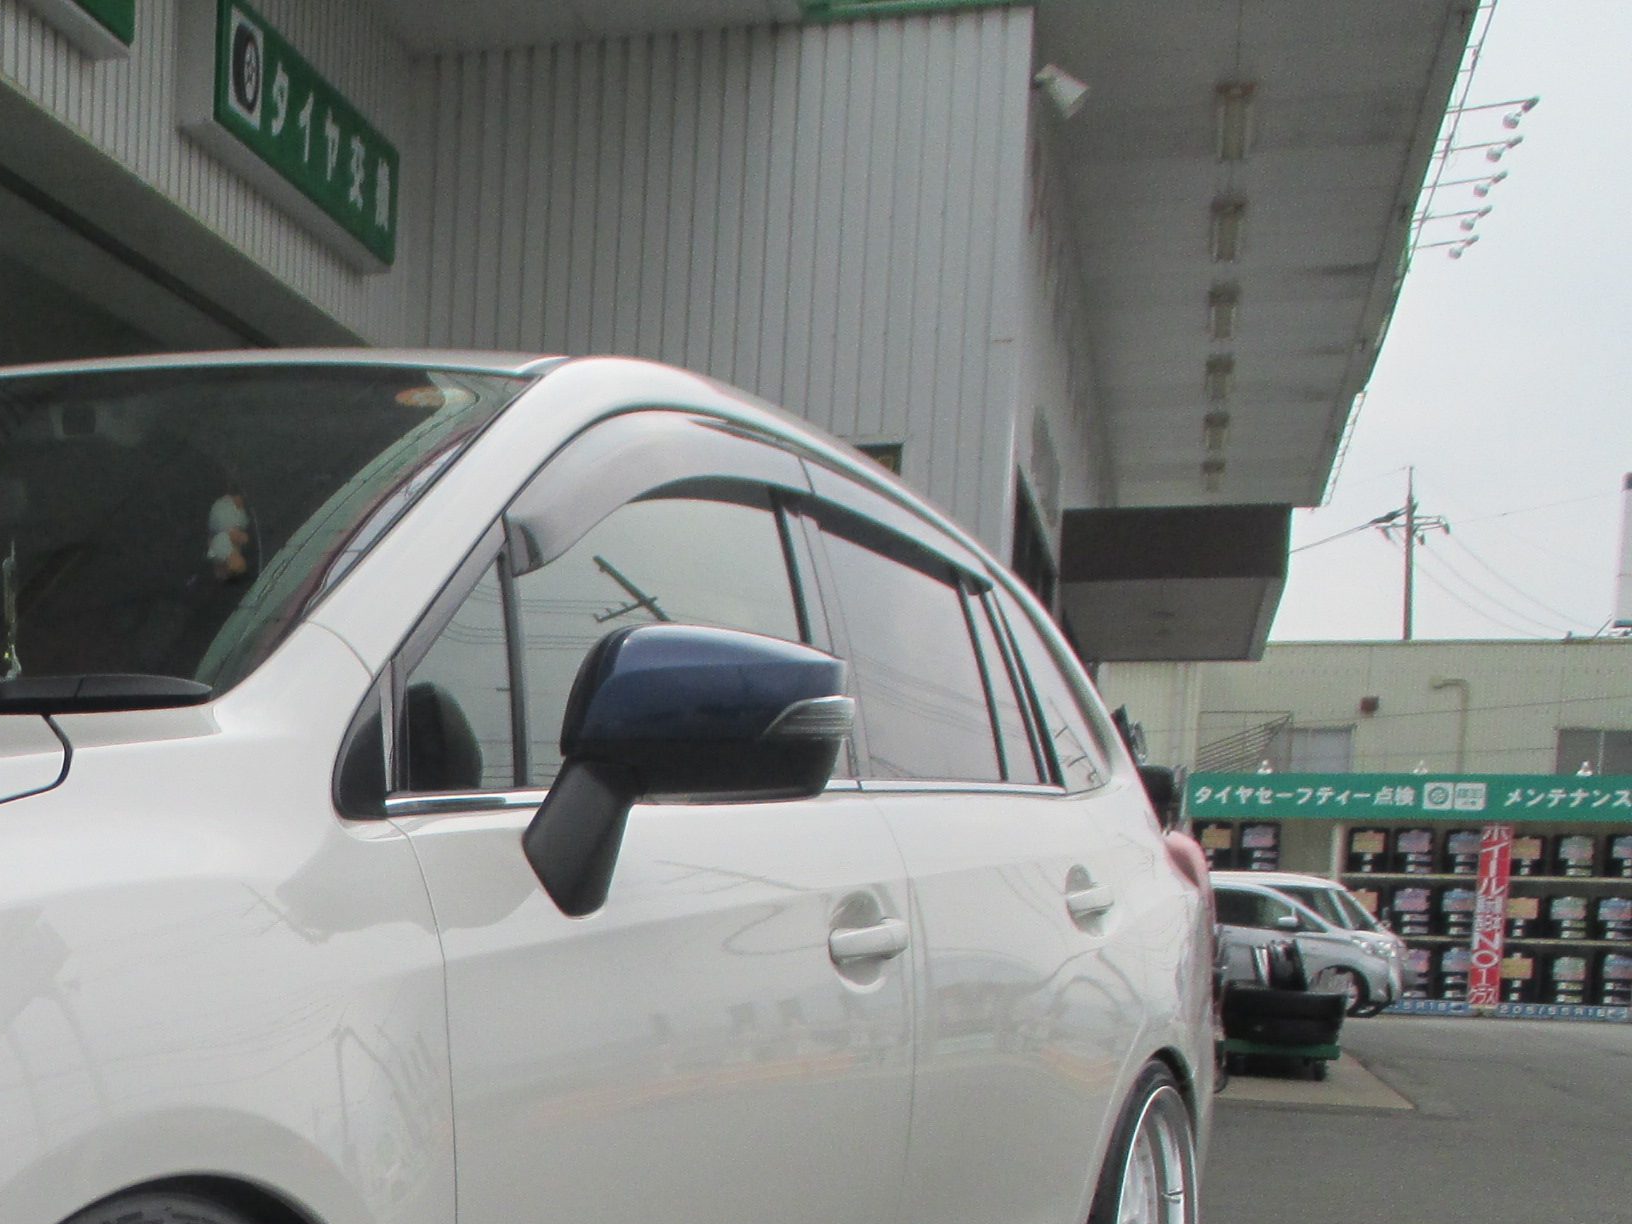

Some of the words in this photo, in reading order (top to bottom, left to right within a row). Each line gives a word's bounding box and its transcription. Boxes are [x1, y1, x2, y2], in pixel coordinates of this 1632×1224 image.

[1194, 785, 1415, 806] タイヤセーフティー点検
[1503, 786, 1632, 808] メンテナンス
